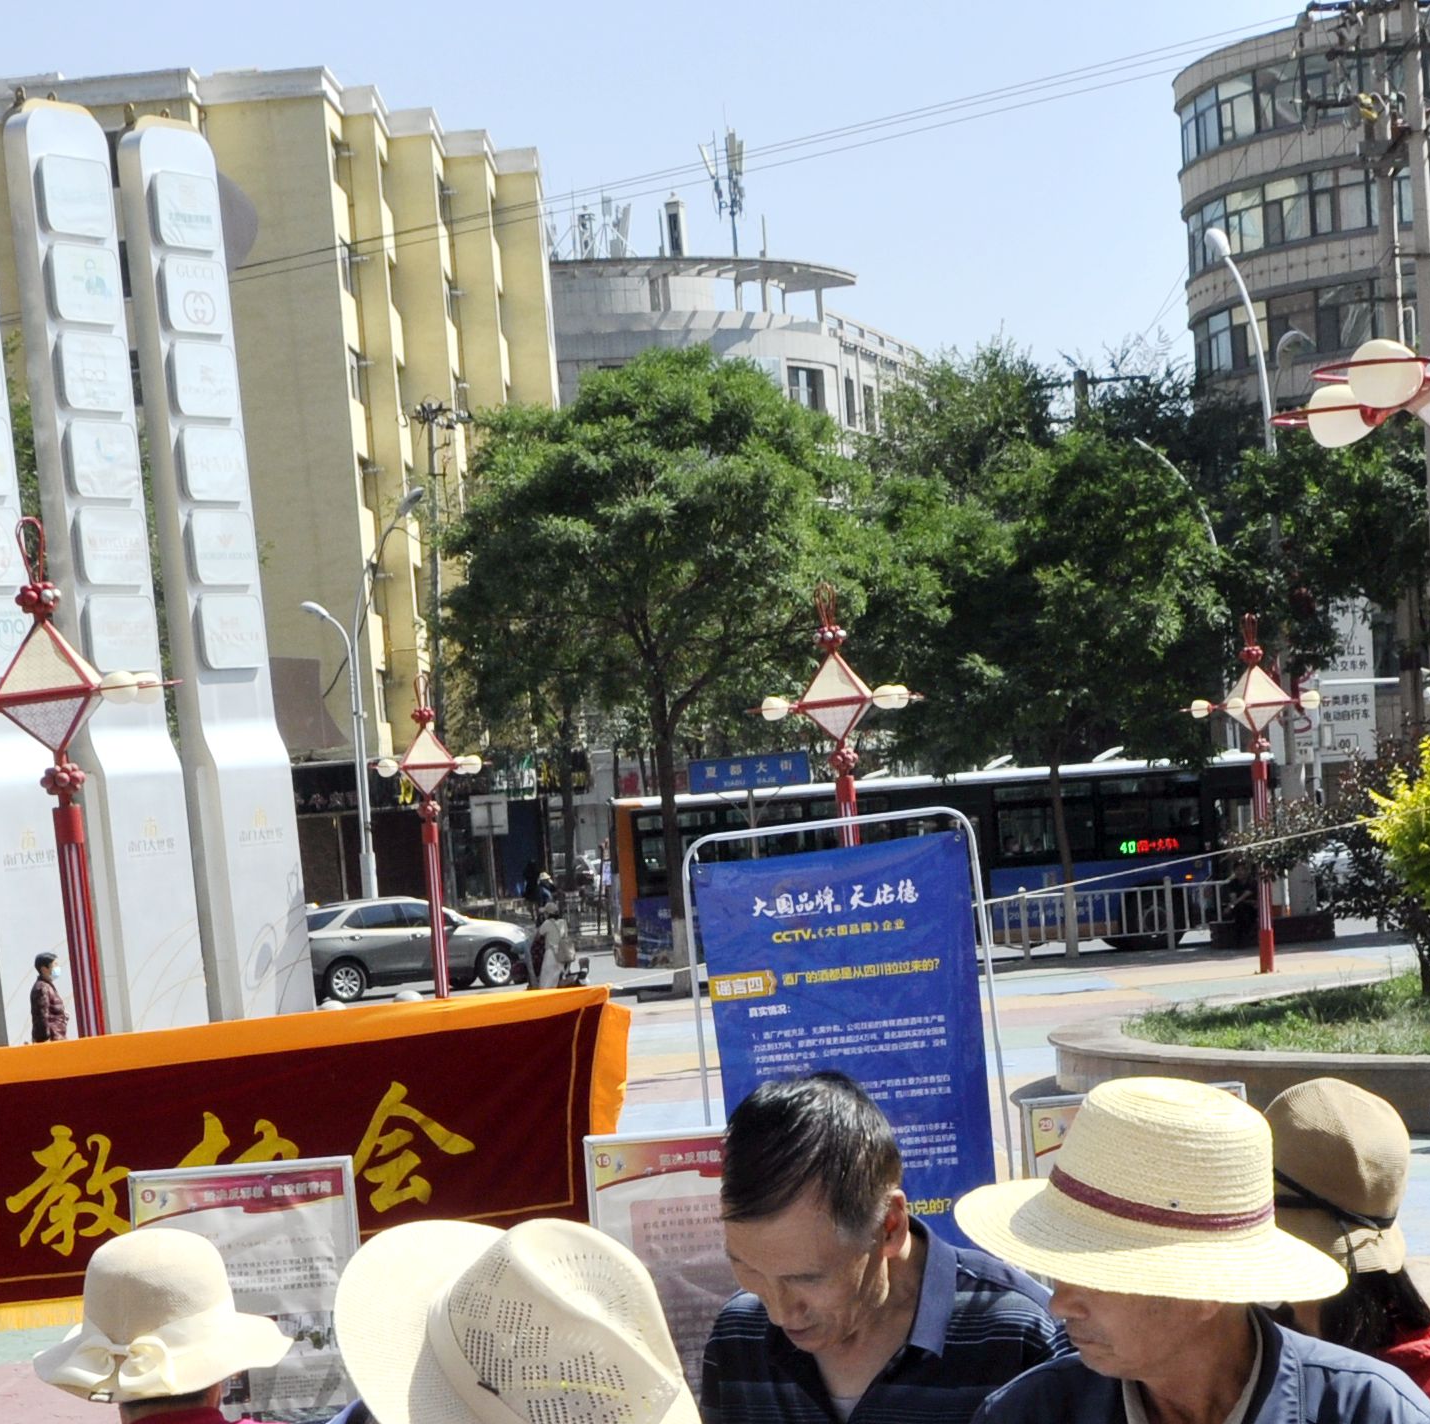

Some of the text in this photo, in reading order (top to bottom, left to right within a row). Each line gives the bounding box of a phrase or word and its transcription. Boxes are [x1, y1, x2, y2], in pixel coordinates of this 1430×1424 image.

[175, 263, 215, 281] GUCCI
[704, 759, 793, 779] 夏都大街
[751, 885, 836, 918] 大国品牌
